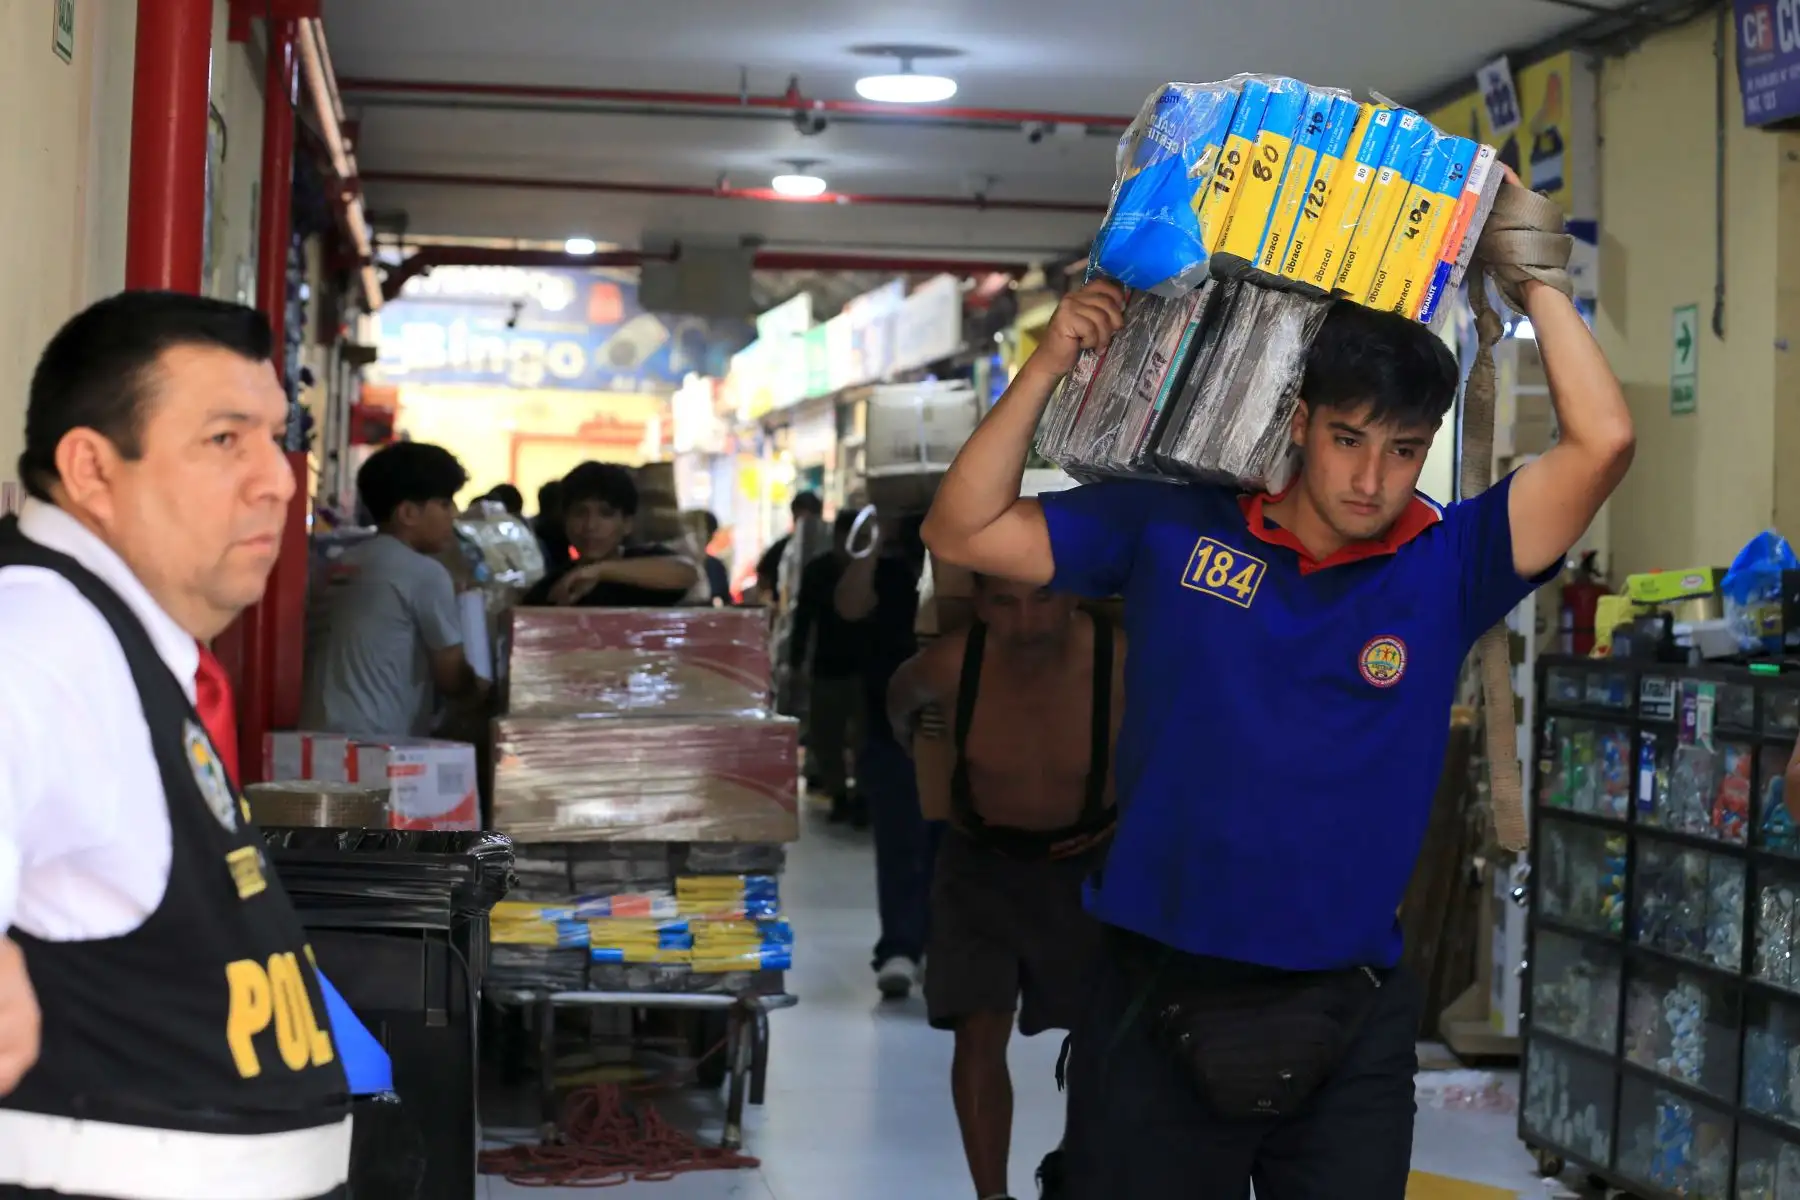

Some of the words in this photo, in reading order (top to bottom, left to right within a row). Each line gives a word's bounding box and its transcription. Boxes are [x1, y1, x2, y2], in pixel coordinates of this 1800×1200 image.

[1306, 111, 1324, 135] 40
[1214, 150, 1241, 193] 150
[1253, 144, 1279, 182] 80
[1357, 168, 1366, 178] 80
[1381, 171, 1390, 181] 60
[1304, 178, 1327, 220] 120
[1404, 208, 1422, 240] 40
[1286, 241, 1304, 273] abracol
[1314, 249, 1333, 282] abracol
[1339, 251, 1357, 283] abracol
[1369, 270, 1387, 303] abracol
[1395, 279, 1412, 312] abracol
[1421, 285, 1437, 315] GRANATE
[1192, 544, 1258, 598] 184
[226, 952, 333, 1078] POL
